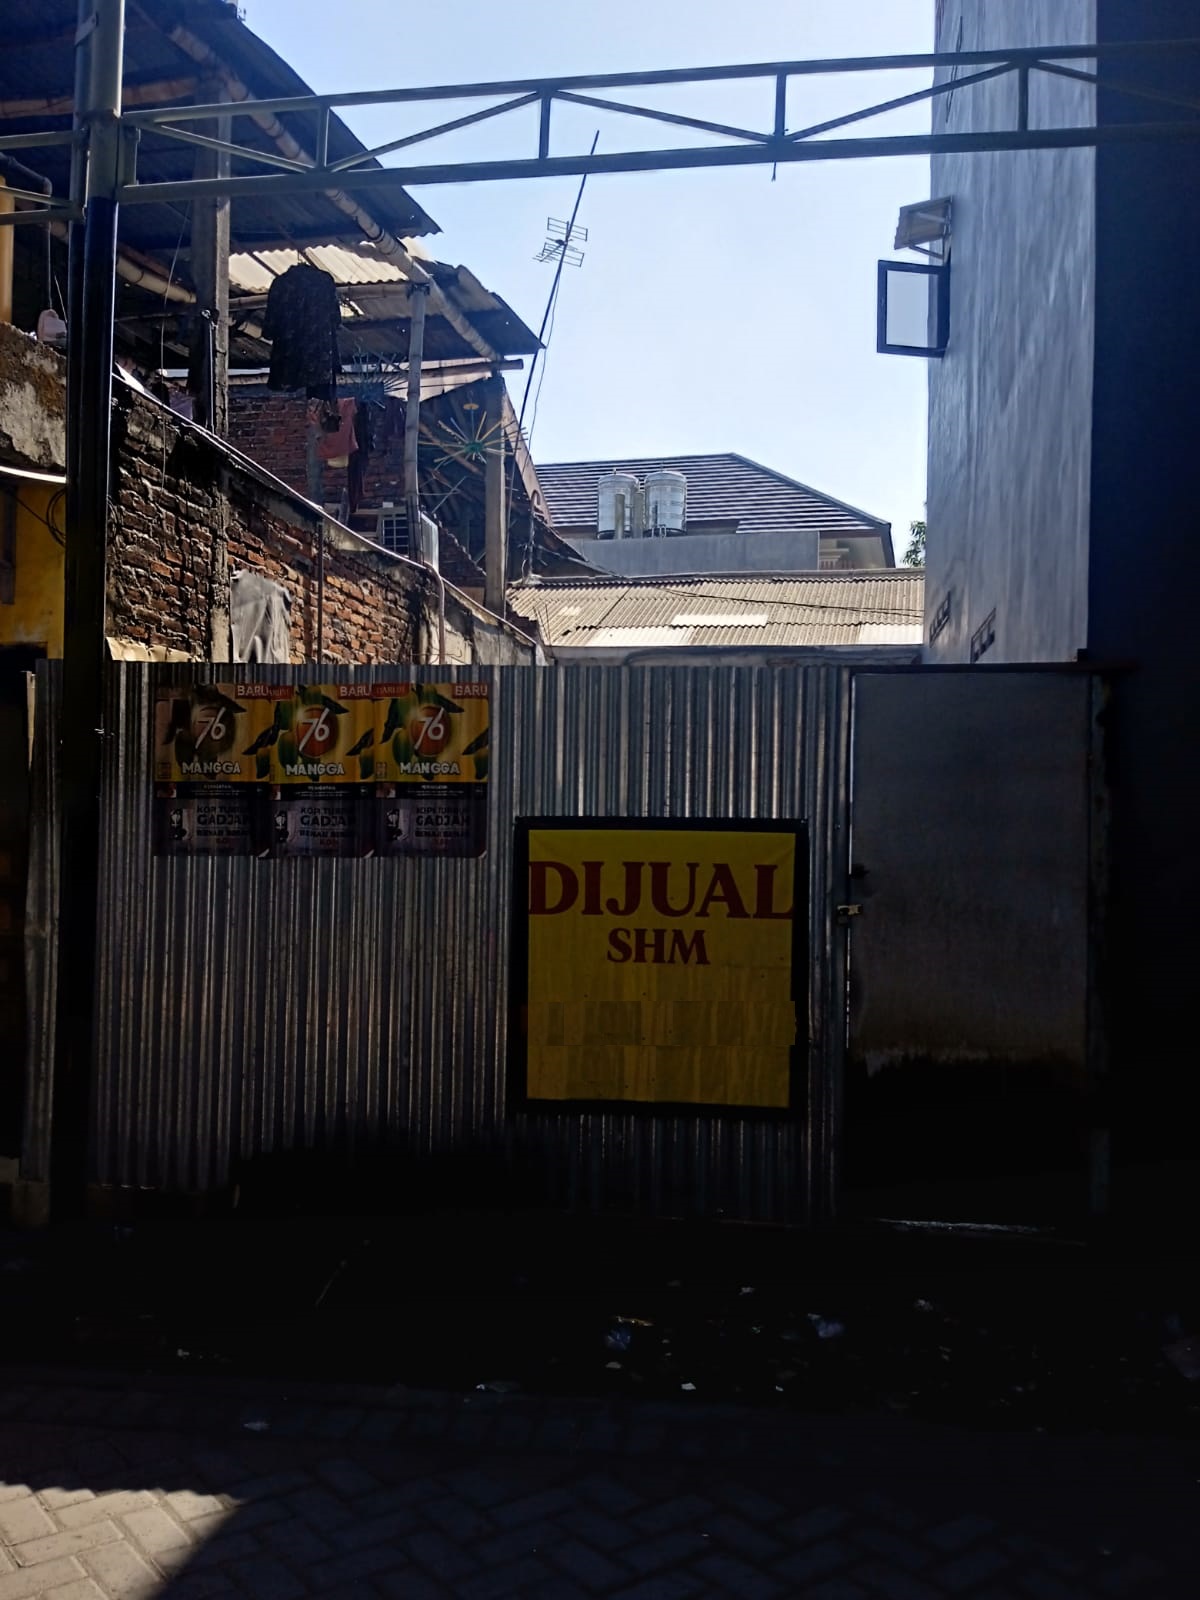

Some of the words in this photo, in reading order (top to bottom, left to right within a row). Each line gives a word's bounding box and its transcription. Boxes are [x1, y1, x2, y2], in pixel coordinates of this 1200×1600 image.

[237, 685, 269, 697] BARU
[455, 684, 488, 697] BARU
[194, 706, 227, 751] 76
[299, 707, 331, 752] 76
[413, 706, 445, 750] 76
[182, 761, 241, 775] MANGGA
[285, 763, 345, 776] MANGGA
[400, 761, 460, 775] MANGGA
[528, 861, 795, 919] DIJUAL
[607, 928, 711, 965] SHM
